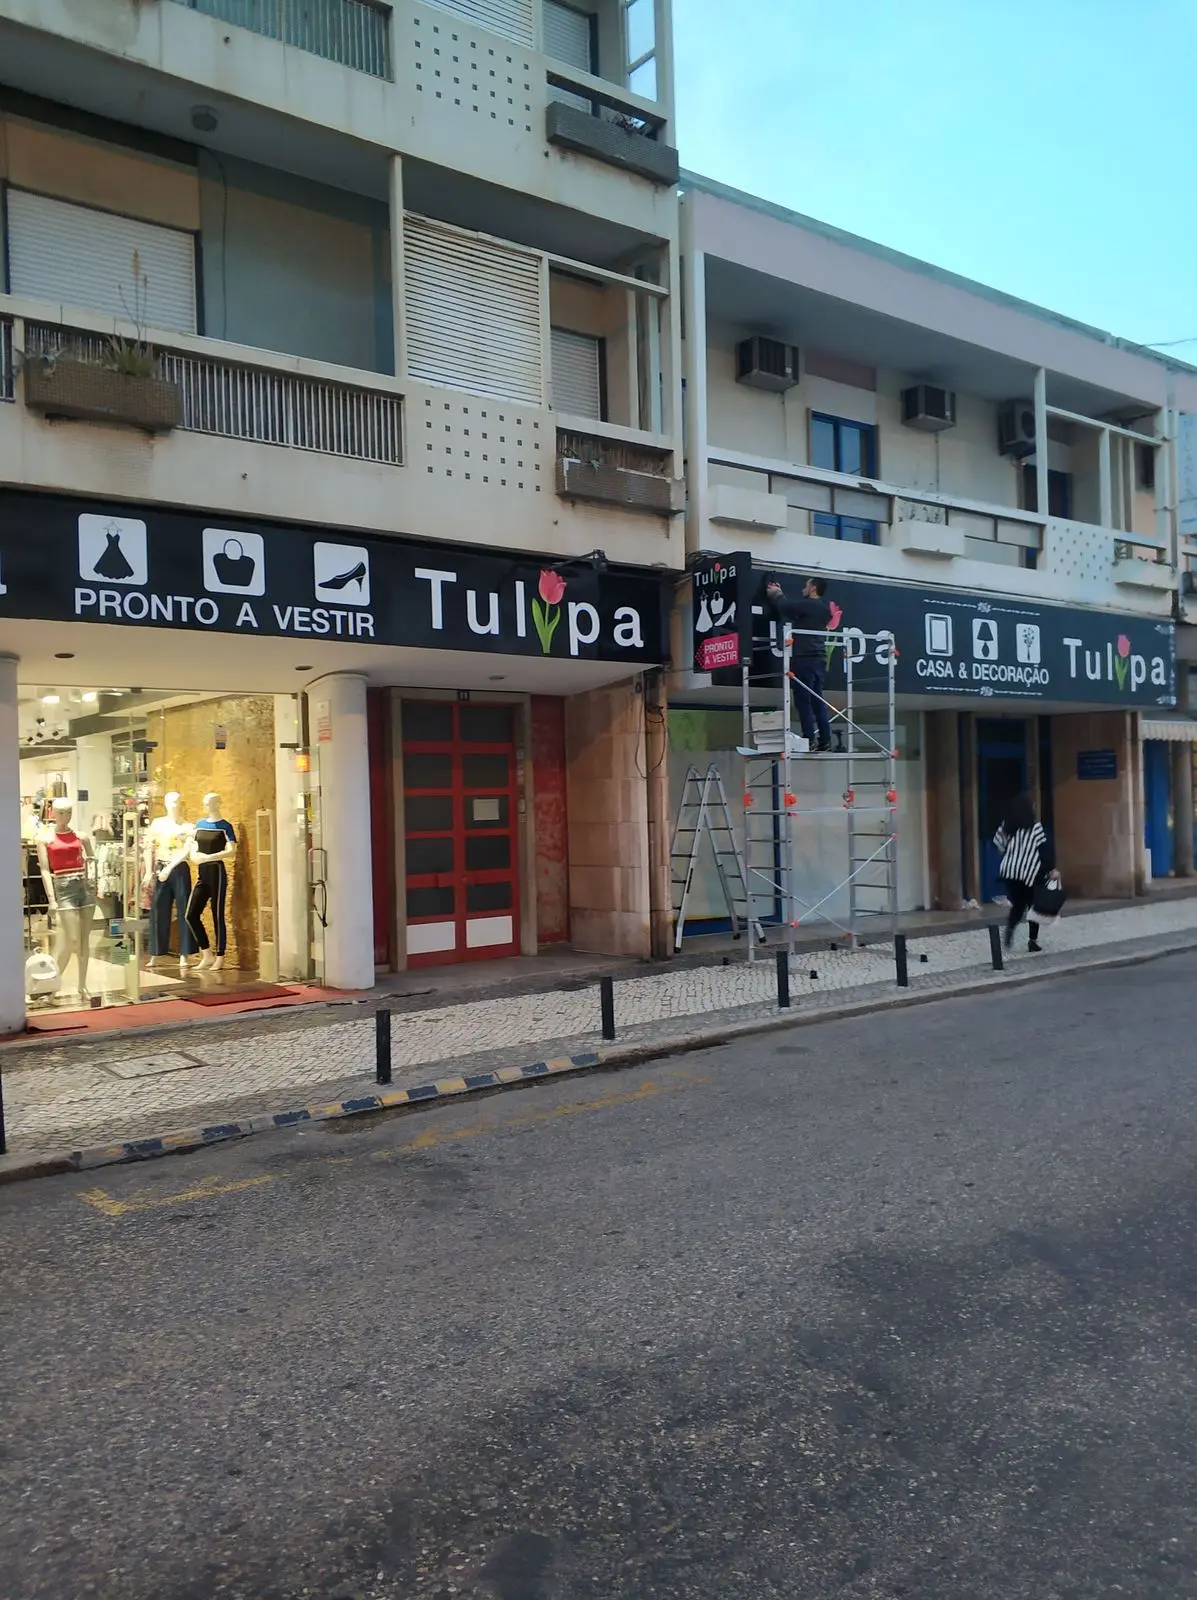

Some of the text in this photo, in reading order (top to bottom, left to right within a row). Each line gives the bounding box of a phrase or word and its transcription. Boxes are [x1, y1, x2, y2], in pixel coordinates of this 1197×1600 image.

[75, 587, 375, 637] PRONTO A VESTIR
[704, 640, 734, 654] PRONTO
[704, 650, 738, 665] A VESTIR
[916, 658, 1050, 687] CASA & DECORAÇÃO
